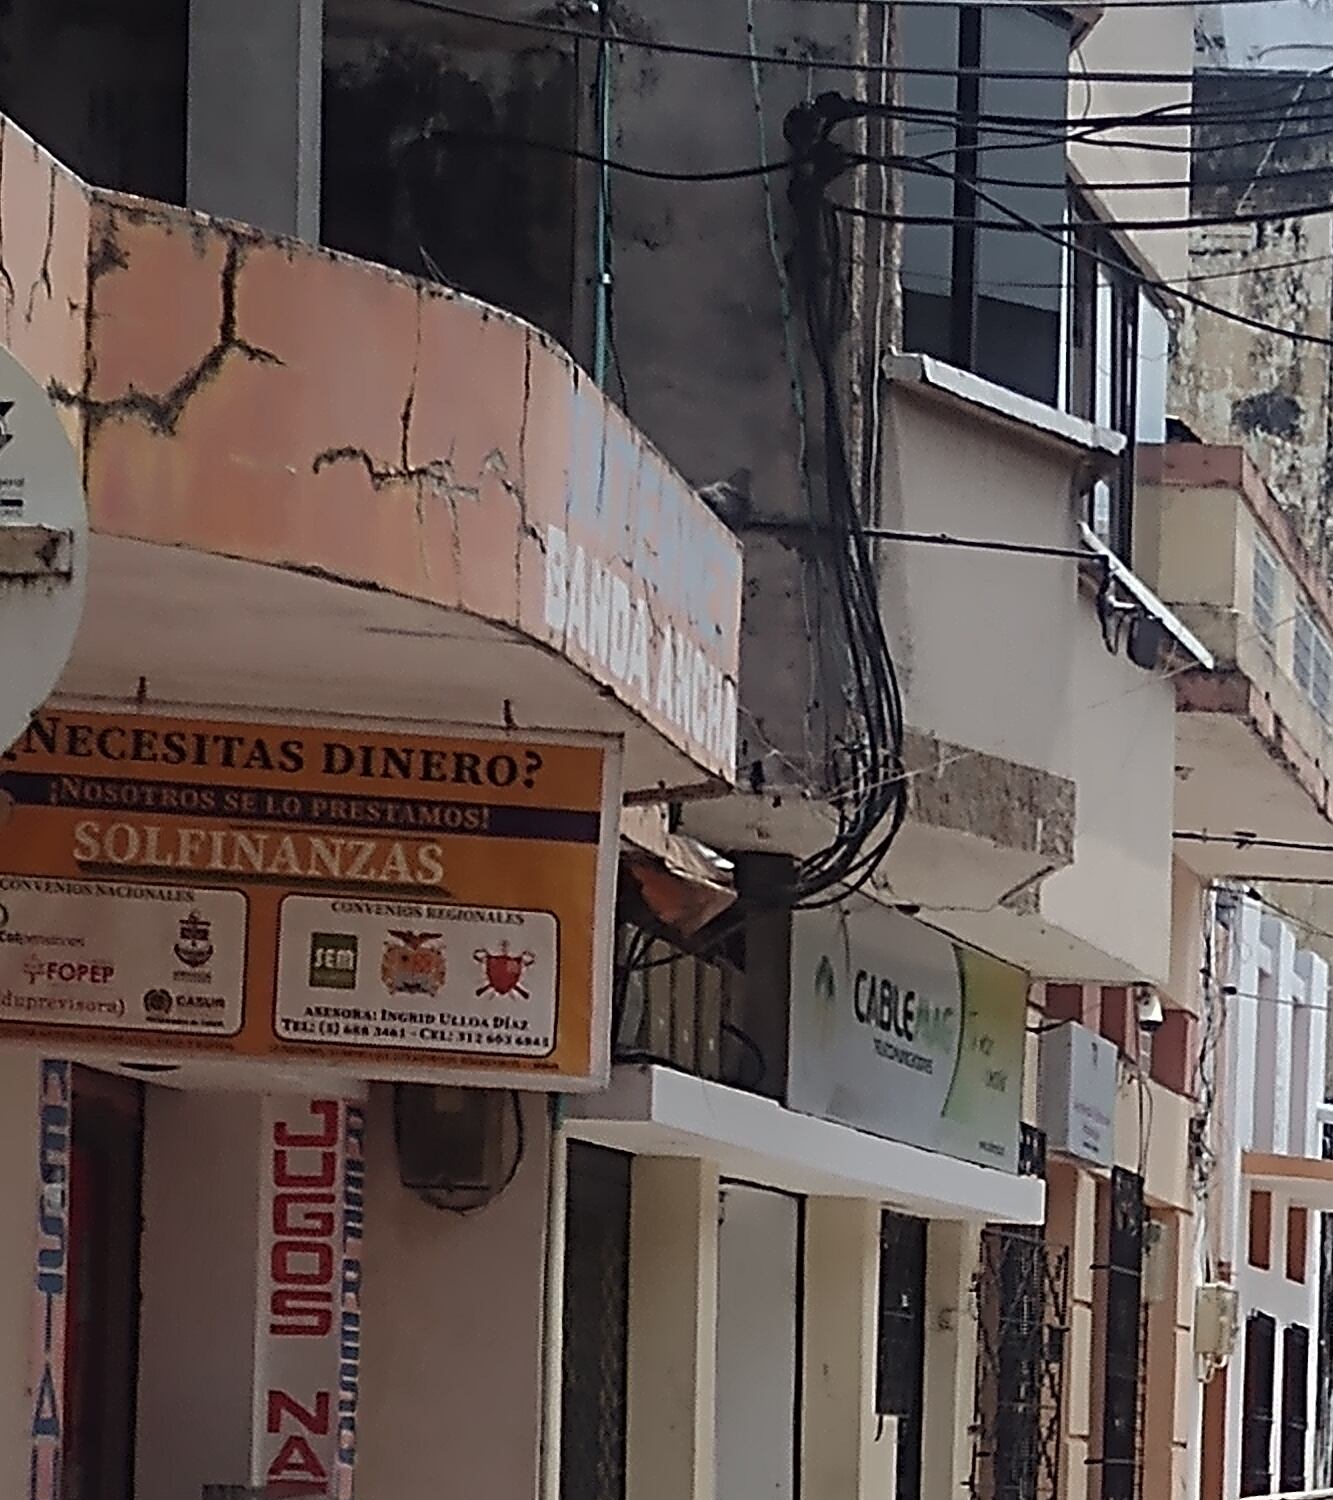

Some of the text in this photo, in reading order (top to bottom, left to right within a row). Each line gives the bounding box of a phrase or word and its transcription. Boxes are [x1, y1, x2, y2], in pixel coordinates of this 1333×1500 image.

[545, 523, 650, 702] BANDA
[322, 742, 544, 789] DINERO?
[223, 791, 258, 813] SE
[265, 794, 301, 816] LO
[73, 819, 445, 886] SOLFINANZAS
[1, 877, 195, 902] CONVENIOS NACIONALES
[331, 900, 525, 925] CONVENIOS REGIONALES
[46, 961, 115, 984] FOPEP
[268, 1099, 339, 1337] JUGOS
